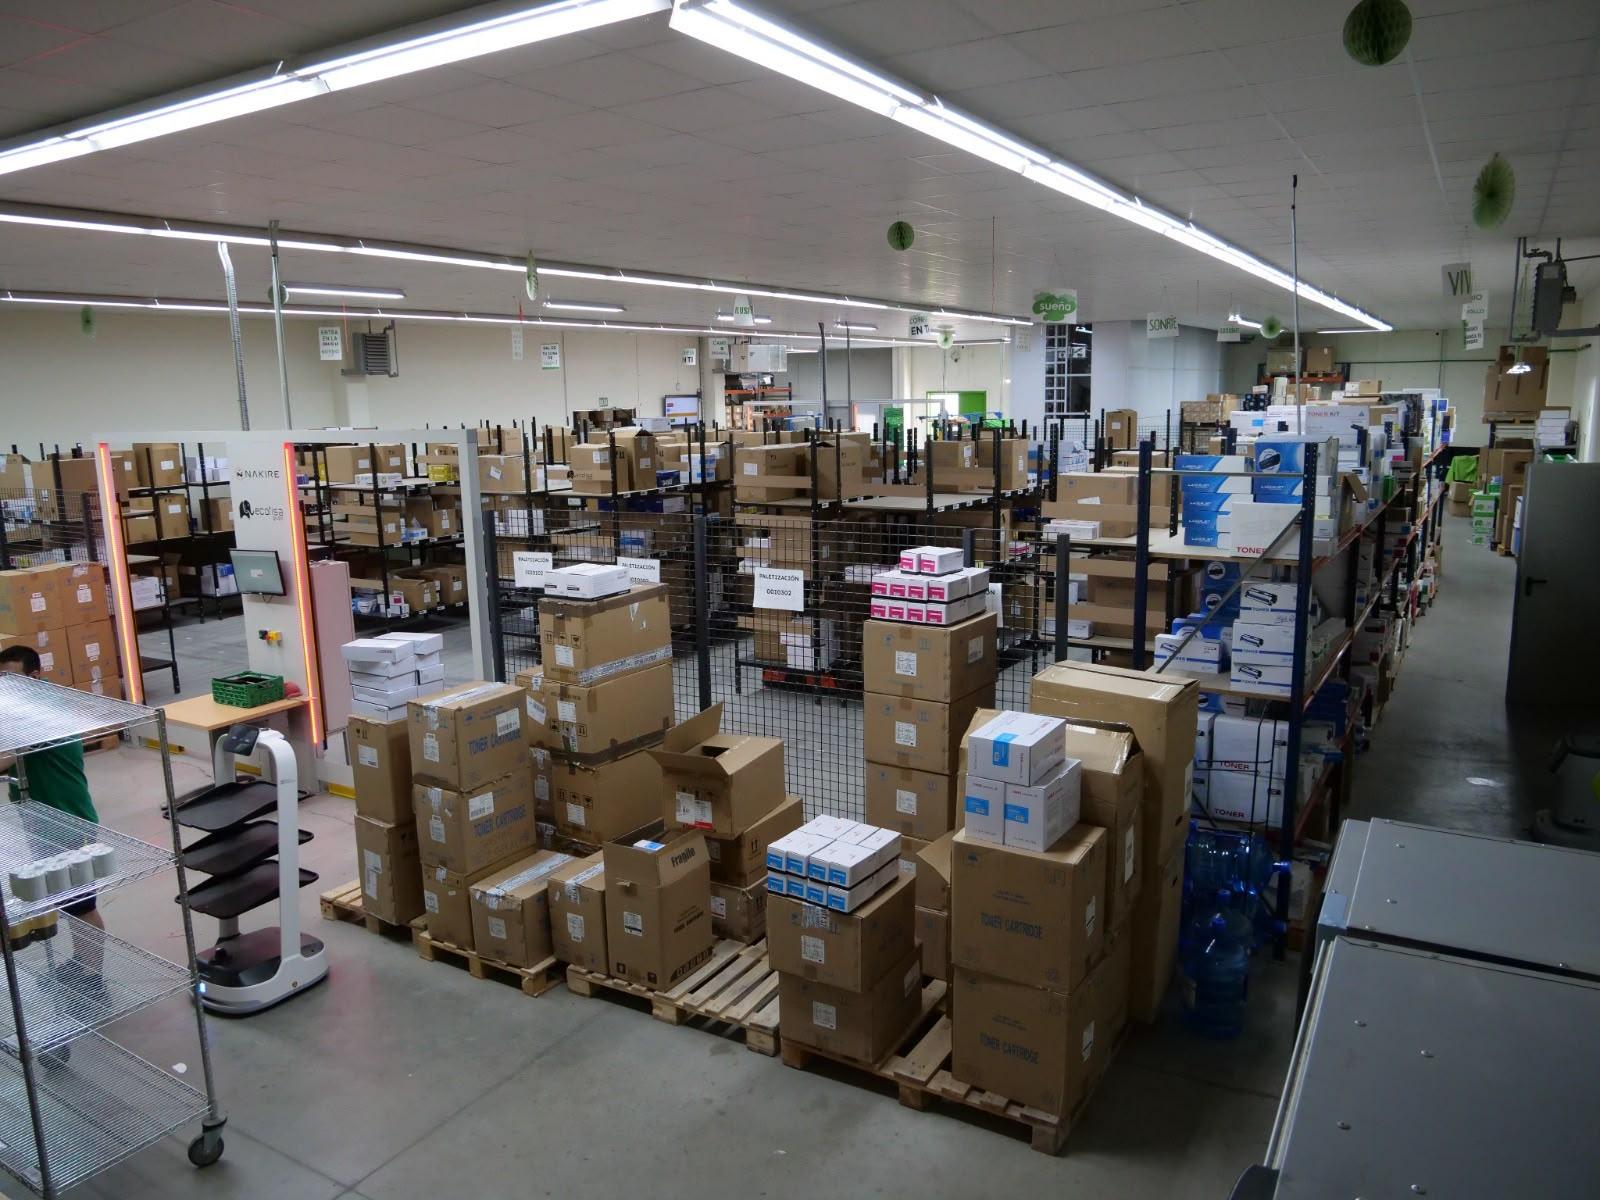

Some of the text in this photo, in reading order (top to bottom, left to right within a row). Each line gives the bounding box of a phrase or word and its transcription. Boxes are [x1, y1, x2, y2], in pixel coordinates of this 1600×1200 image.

[1039, 301, 1072, 311] sueña
[911, 325, 923, 336] EN
[244, 470, 280, 478] NAKIRE
[759, 573, 800, 581] PALETIZACIÓN
[469, 736, 489, 756] TONER
[1220, 761, 1249, 770] TONER
[1215, 808, 1245, 818] TONER
[474, 805, 527, 838] TONER CARTRIDGE
[671, 847, 696, 868] Fragile
[980, 912, 1043, 940] TONER CARTRIDGE
[980, 1033, 1039, 1065] TONER CARTRIDGE
